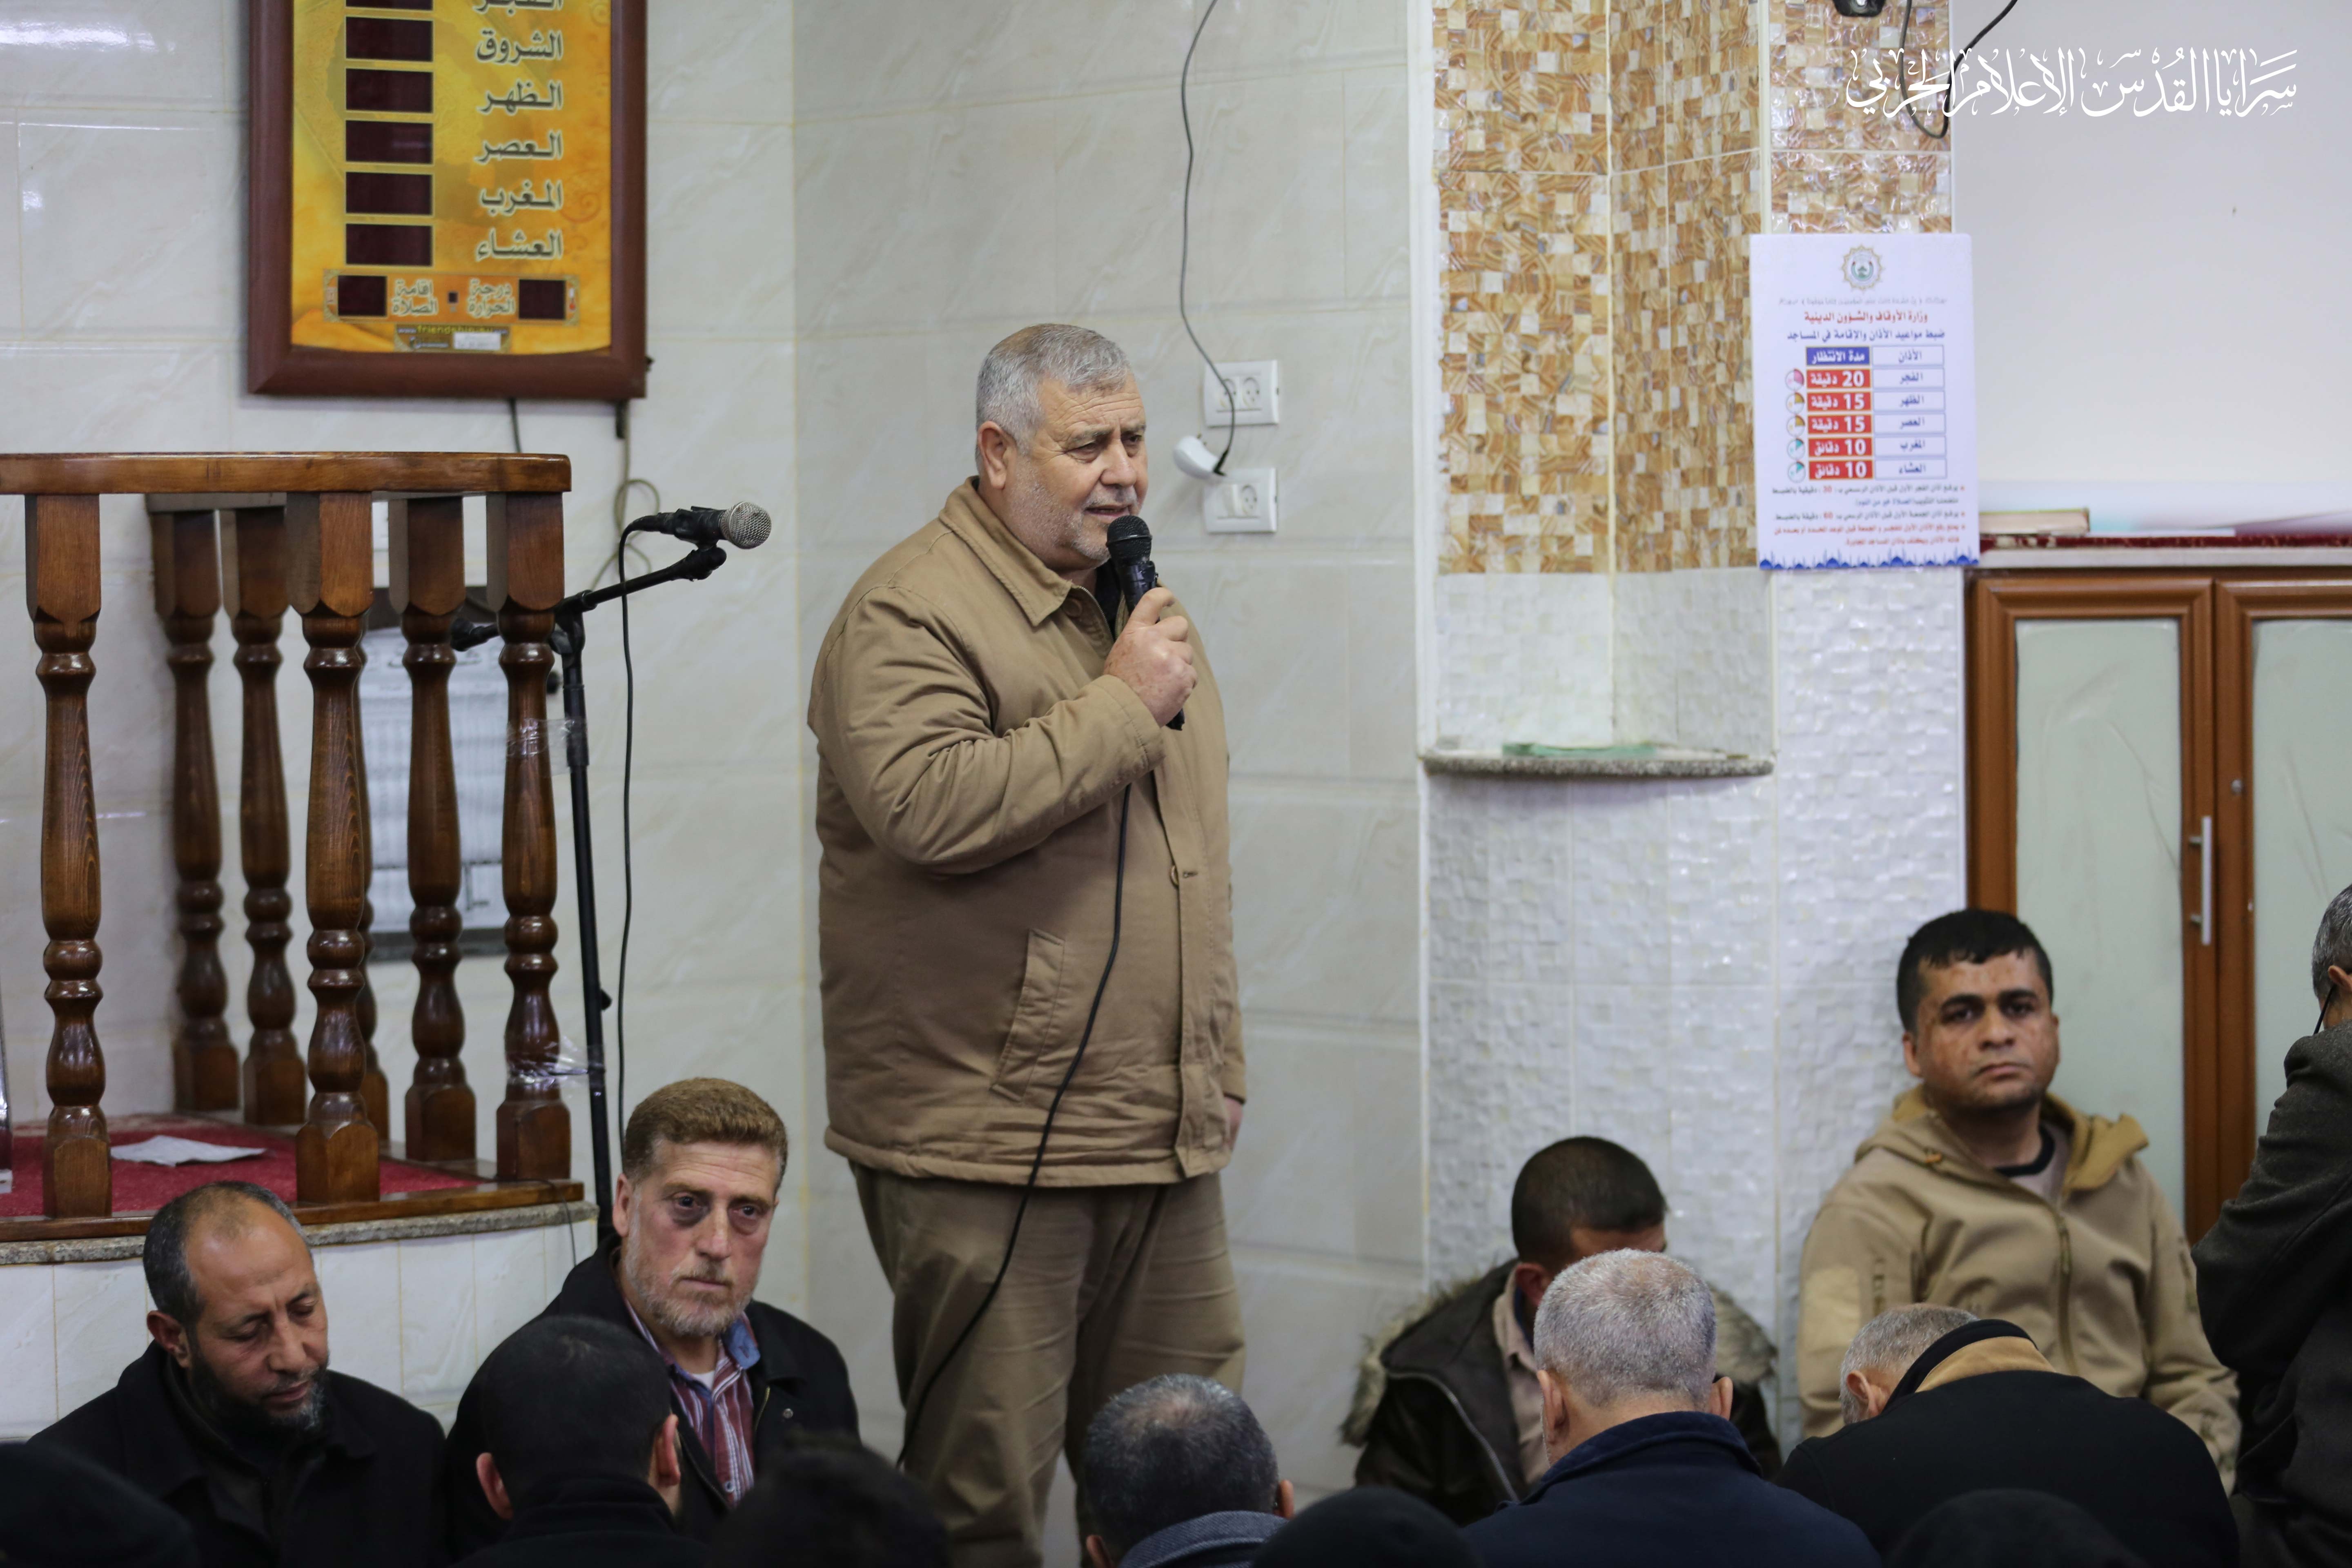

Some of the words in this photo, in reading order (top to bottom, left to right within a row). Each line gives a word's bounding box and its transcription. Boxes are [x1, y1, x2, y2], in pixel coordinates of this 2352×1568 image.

[476, 30, 564, 65] الشروق
[481, 80, 564, 115] الظهر
[476, 133, 564, 166] العصر
[479, 180, 564, 216] المغرب
[474, 229, 564, 262] العشاء
[469, 278, 512, 298] درجة
[392, 297, 438, 316] الصلاة
[468, 297, 515, 318] الحرارة
[1804, 311, 1834, 325] الدينية
[1838, 310, 1873, 323] والشؤون
[1875, 309, 1906, 323] الأوقاف
[1908, 310, 1928, 323] وزارة
[1788, 330, 1818, 342] المساجد
[1822, 330, 1831, 342] في
[1869, 327, 1892, 341] الأذان
[1895, 330, 1922, 341] مواعيد
[1926, 329, 1944, 341] ضبط
[1812, 351, 1846, 364] الانتظار
[1849, 351, 1865, 361] مدة
[1899, 350, 1922, 363] الأذان
[1811, 372, 1838, 388] دقيقة
[1842, 371, 1864, 387] 20
[1900, 373, 1923, 385] الفجر
[1811, 395, 1838, 410] دقيقة
[1844, 394, 1864, 410] 15
[1900, 396, 1924, 408] الظهر
[1812, 418, 1839, 433] دقيقة
[1844, 416, 1865, 432] 15
[1900, 418, 1924, 429] العصر
[1815, 441, 1839, 456] دقائق
[1845, 439, 1866, 455] 10
[1900, 441, 1925, 450] المغرب
[1815, 464, 1840, 479] دقائق
[1846, 462, 1867, 478] 10
[1899, 462, 1926, 474] العشاء
